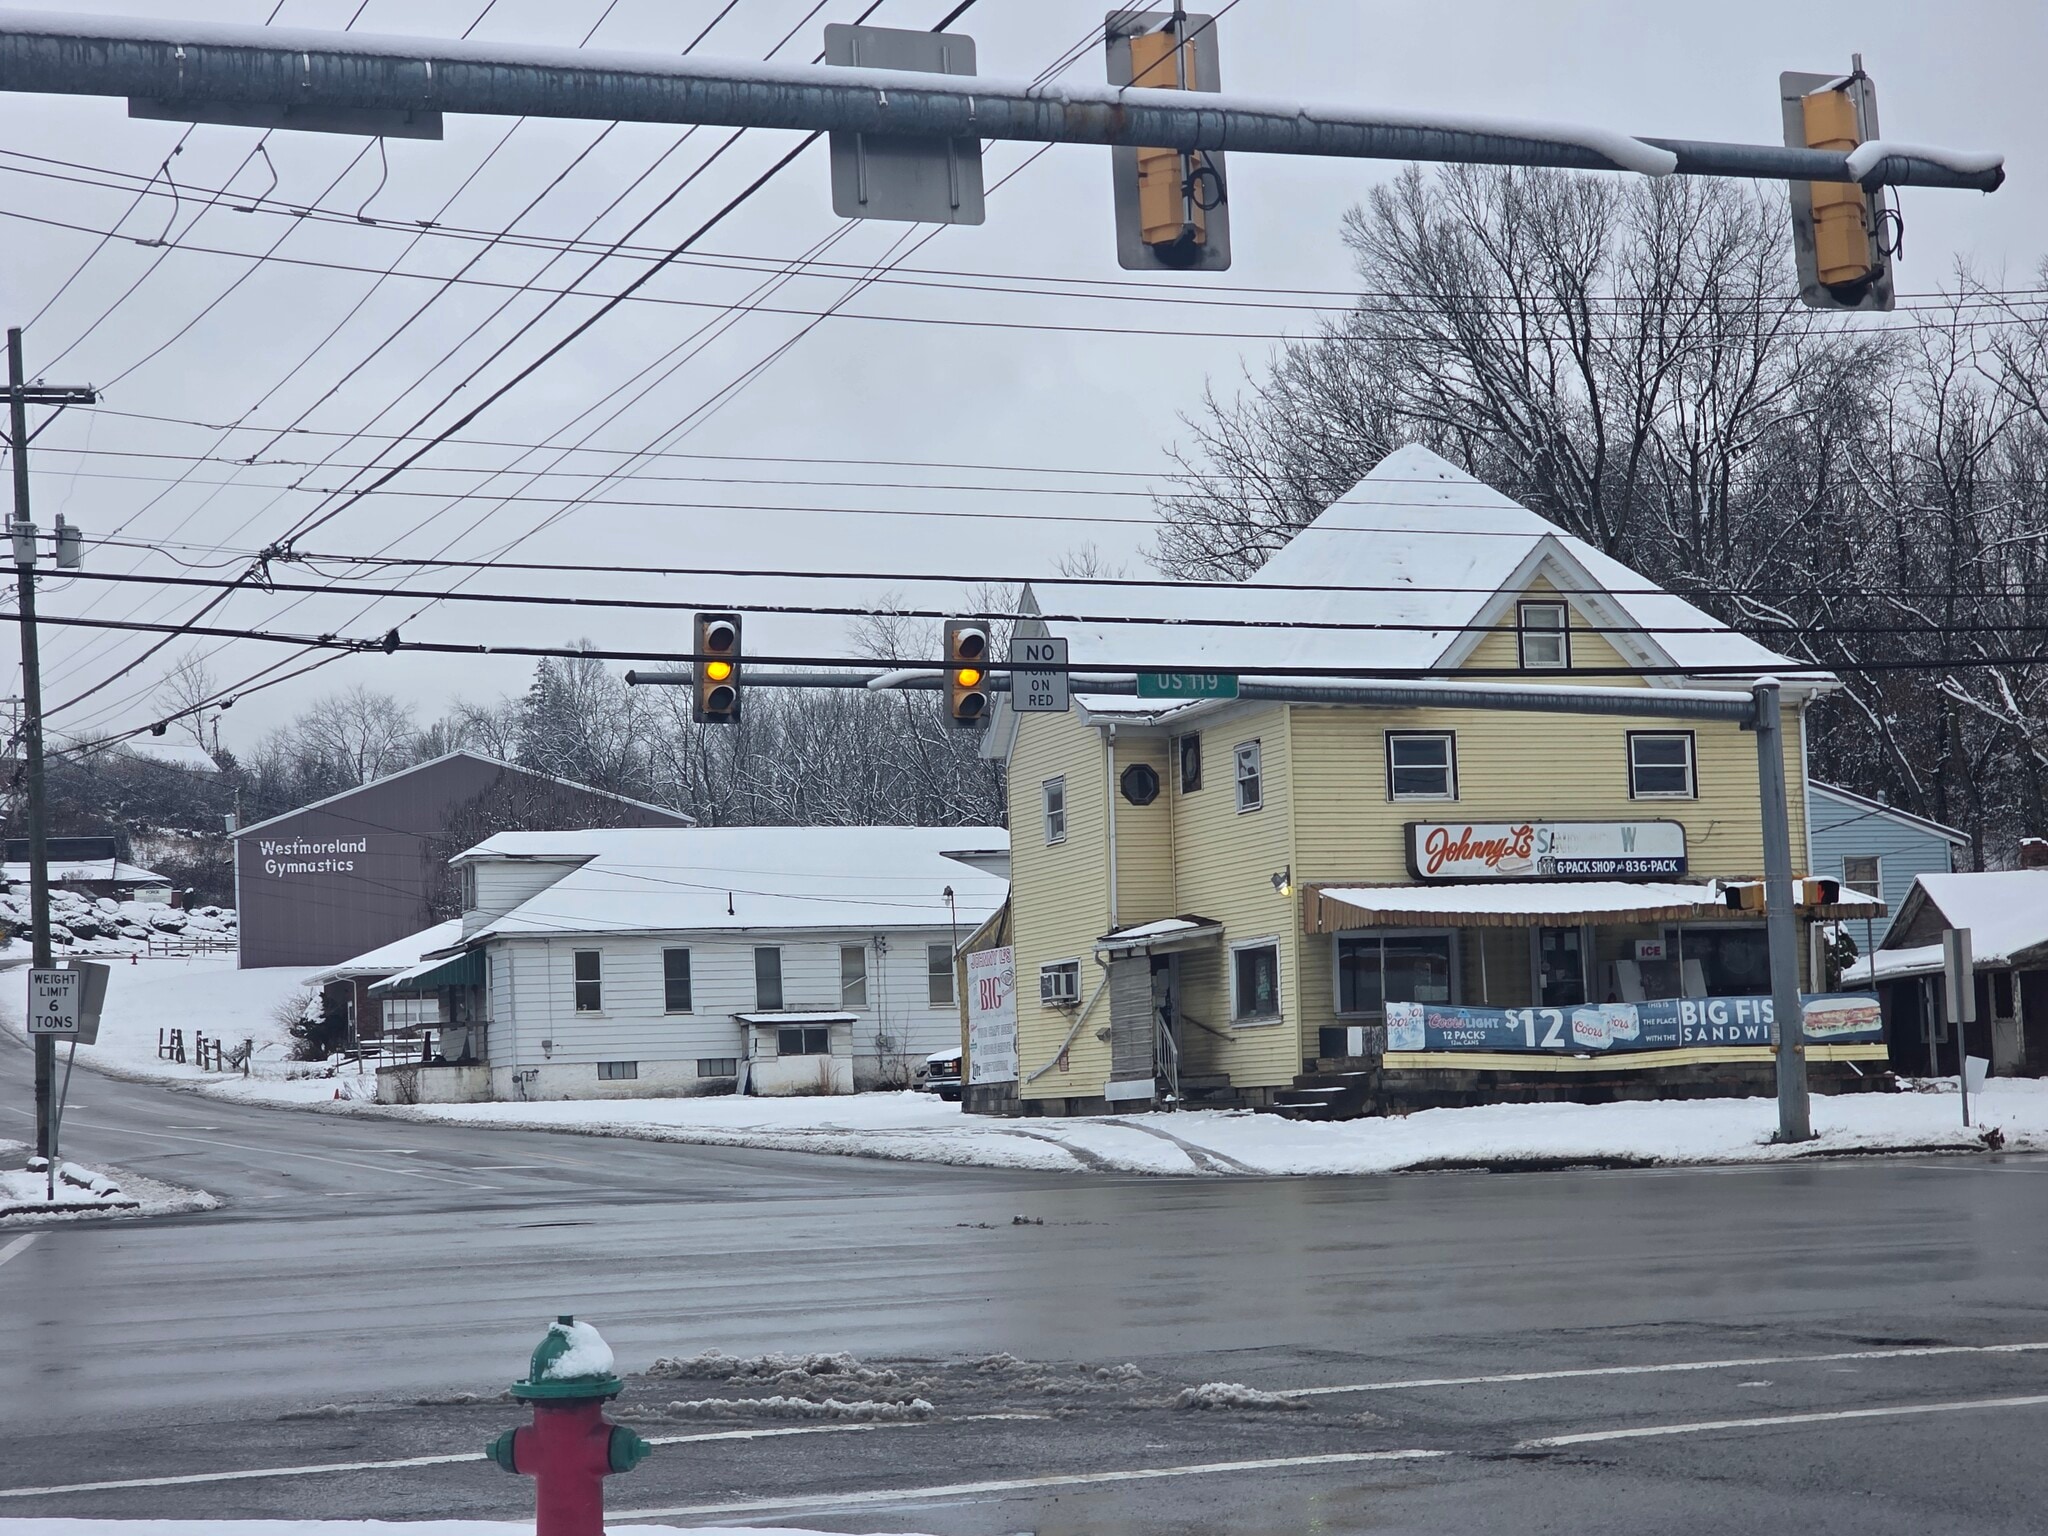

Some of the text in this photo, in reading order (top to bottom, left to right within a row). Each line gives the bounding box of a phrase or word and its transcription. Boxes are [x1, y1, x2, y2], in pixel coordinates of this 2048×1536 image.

[1027, 644, 1054, 661] NO
[1031, 679, 1050, 691] ON
[1158, 674, 1218, 690] US 119
[1029, 694, 1054, 706] RED
[260, 837, 366, 856] Westmoreland
[1425, 826, 1509, 874] Johnny
[265, 859, 354, 878] Gymnastics
[1592, 860, 1616, 873] SHOP
[1641, 946, 1661, 957] ICE
[34, 974, 76, 985] WEIGHT
[39, 986, 69, 997] LIMIT
[979, 976, 1002, 1011] BIG
[49, 999, 59, 1012] 6
[1680, 999, 1774, 1025] BIG FIS
[35, 1015, 73, 1028] TONS
[1427, 1013, 1465, 1029] Coors
[1465, 1018, 1500, 1029] LIGHT
[1504, 1009, 1565, 1047] $12
[1573, 1020, 1603, 1038] Coors
[1656, 1017, 1677, 1025] PLACE
[1442, 1031, 1486, 1040] 12 PACKS
[1684, 1025, 1768, 1041] SANDWI
